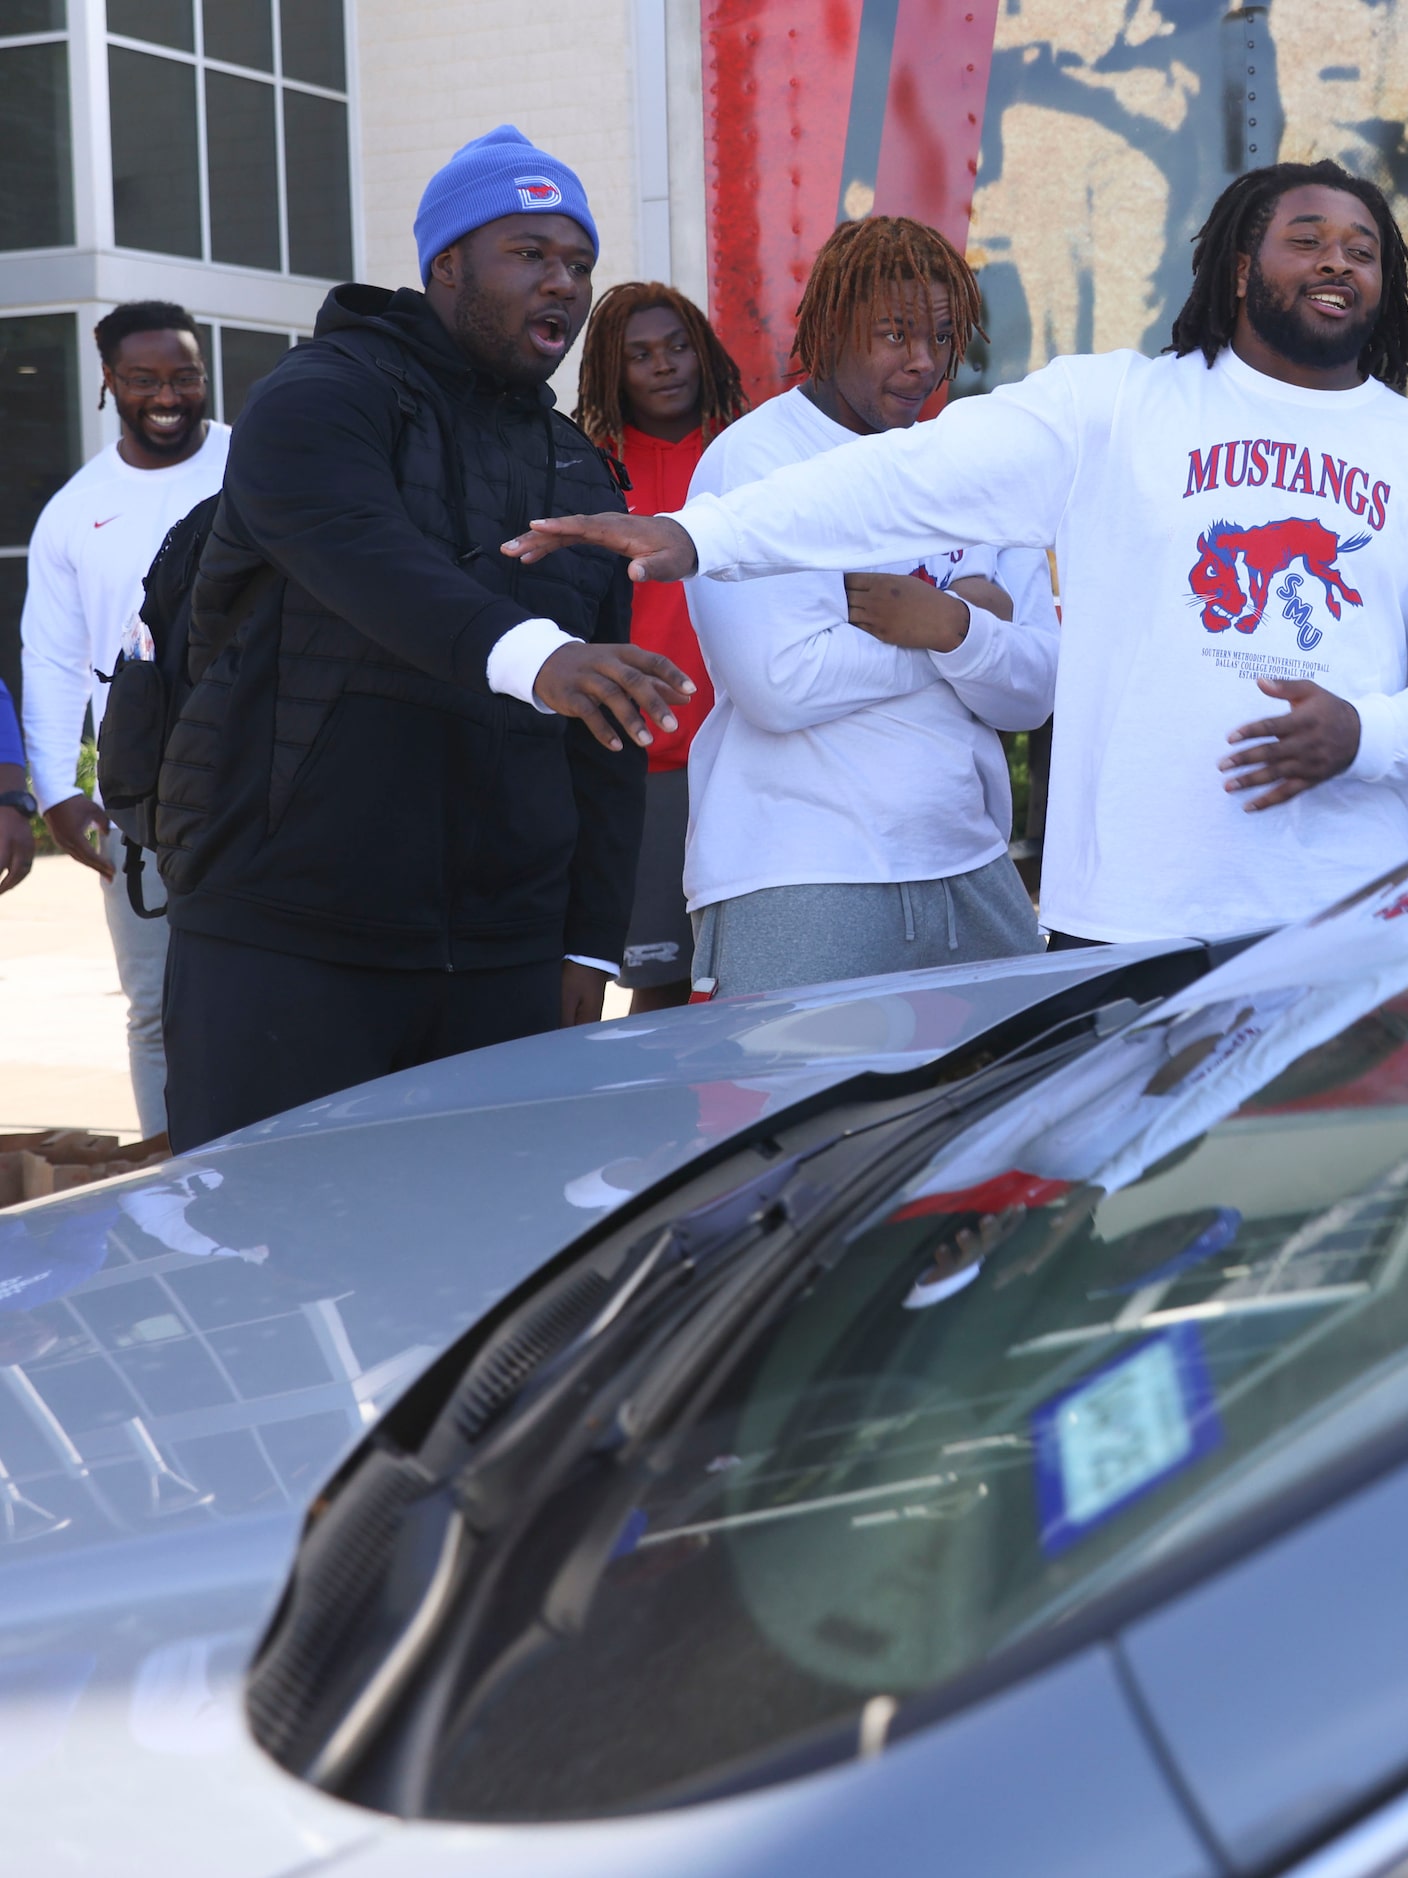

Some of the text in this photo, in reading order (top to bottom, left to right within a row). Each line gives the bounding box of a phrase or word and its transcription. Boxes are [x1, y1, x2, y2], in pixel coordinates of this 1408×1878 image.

[1183, 439, 1391, 531] MUSTANGS
[1276, 573, 1323, 651] SMU
[1201, 648, 1330, 673] SOUTHERN METHODIST UNIVERSITY FOOTBALL
[1240, 661, 1267, 673] COLLEGE
[1269, 665, 1298, 677] FOOTBALL
[1299, 669, 1315, 679] TEAM
